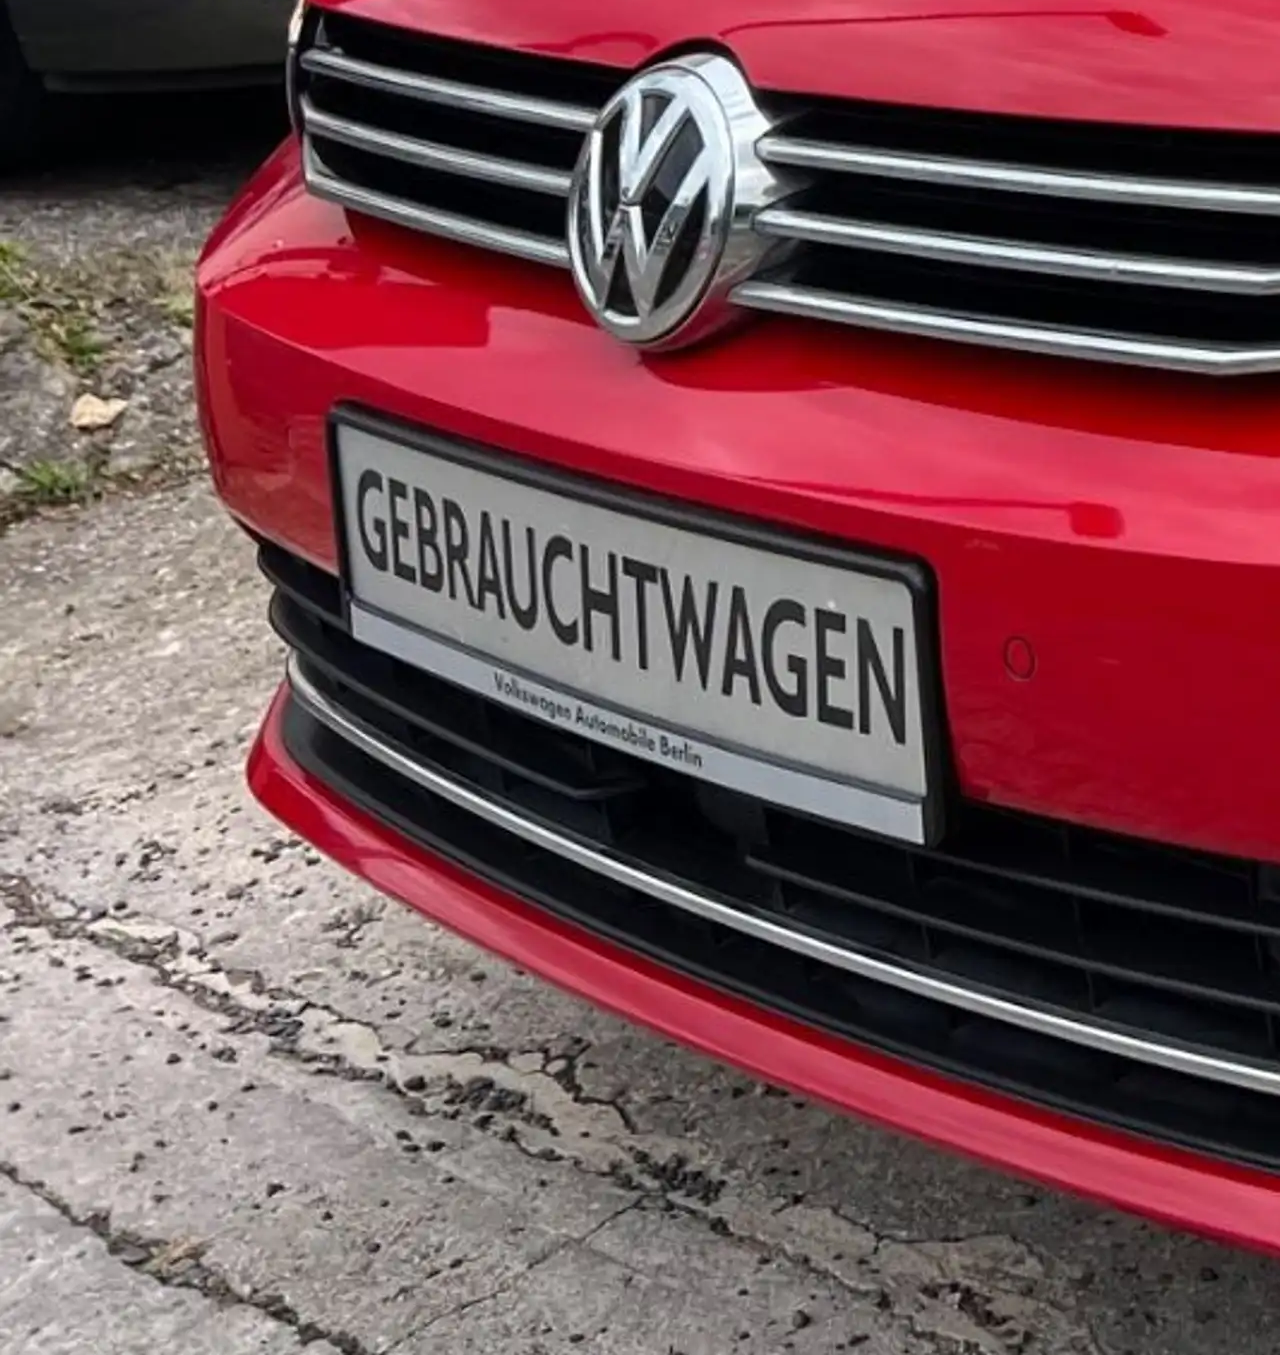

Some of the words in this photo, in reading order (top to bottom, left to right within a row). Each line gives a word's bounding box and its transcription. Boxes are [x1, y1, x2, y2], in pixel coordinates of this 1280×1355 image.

[570, 66, 733, 342] VW
[356, 468, 906, 746] GEBRAUCHTWAGEN
[494, 672, 572, 719] Volkswagen
[575, 706, 656, 752] Automobile
[659, 736, 703, 769] Berlin
